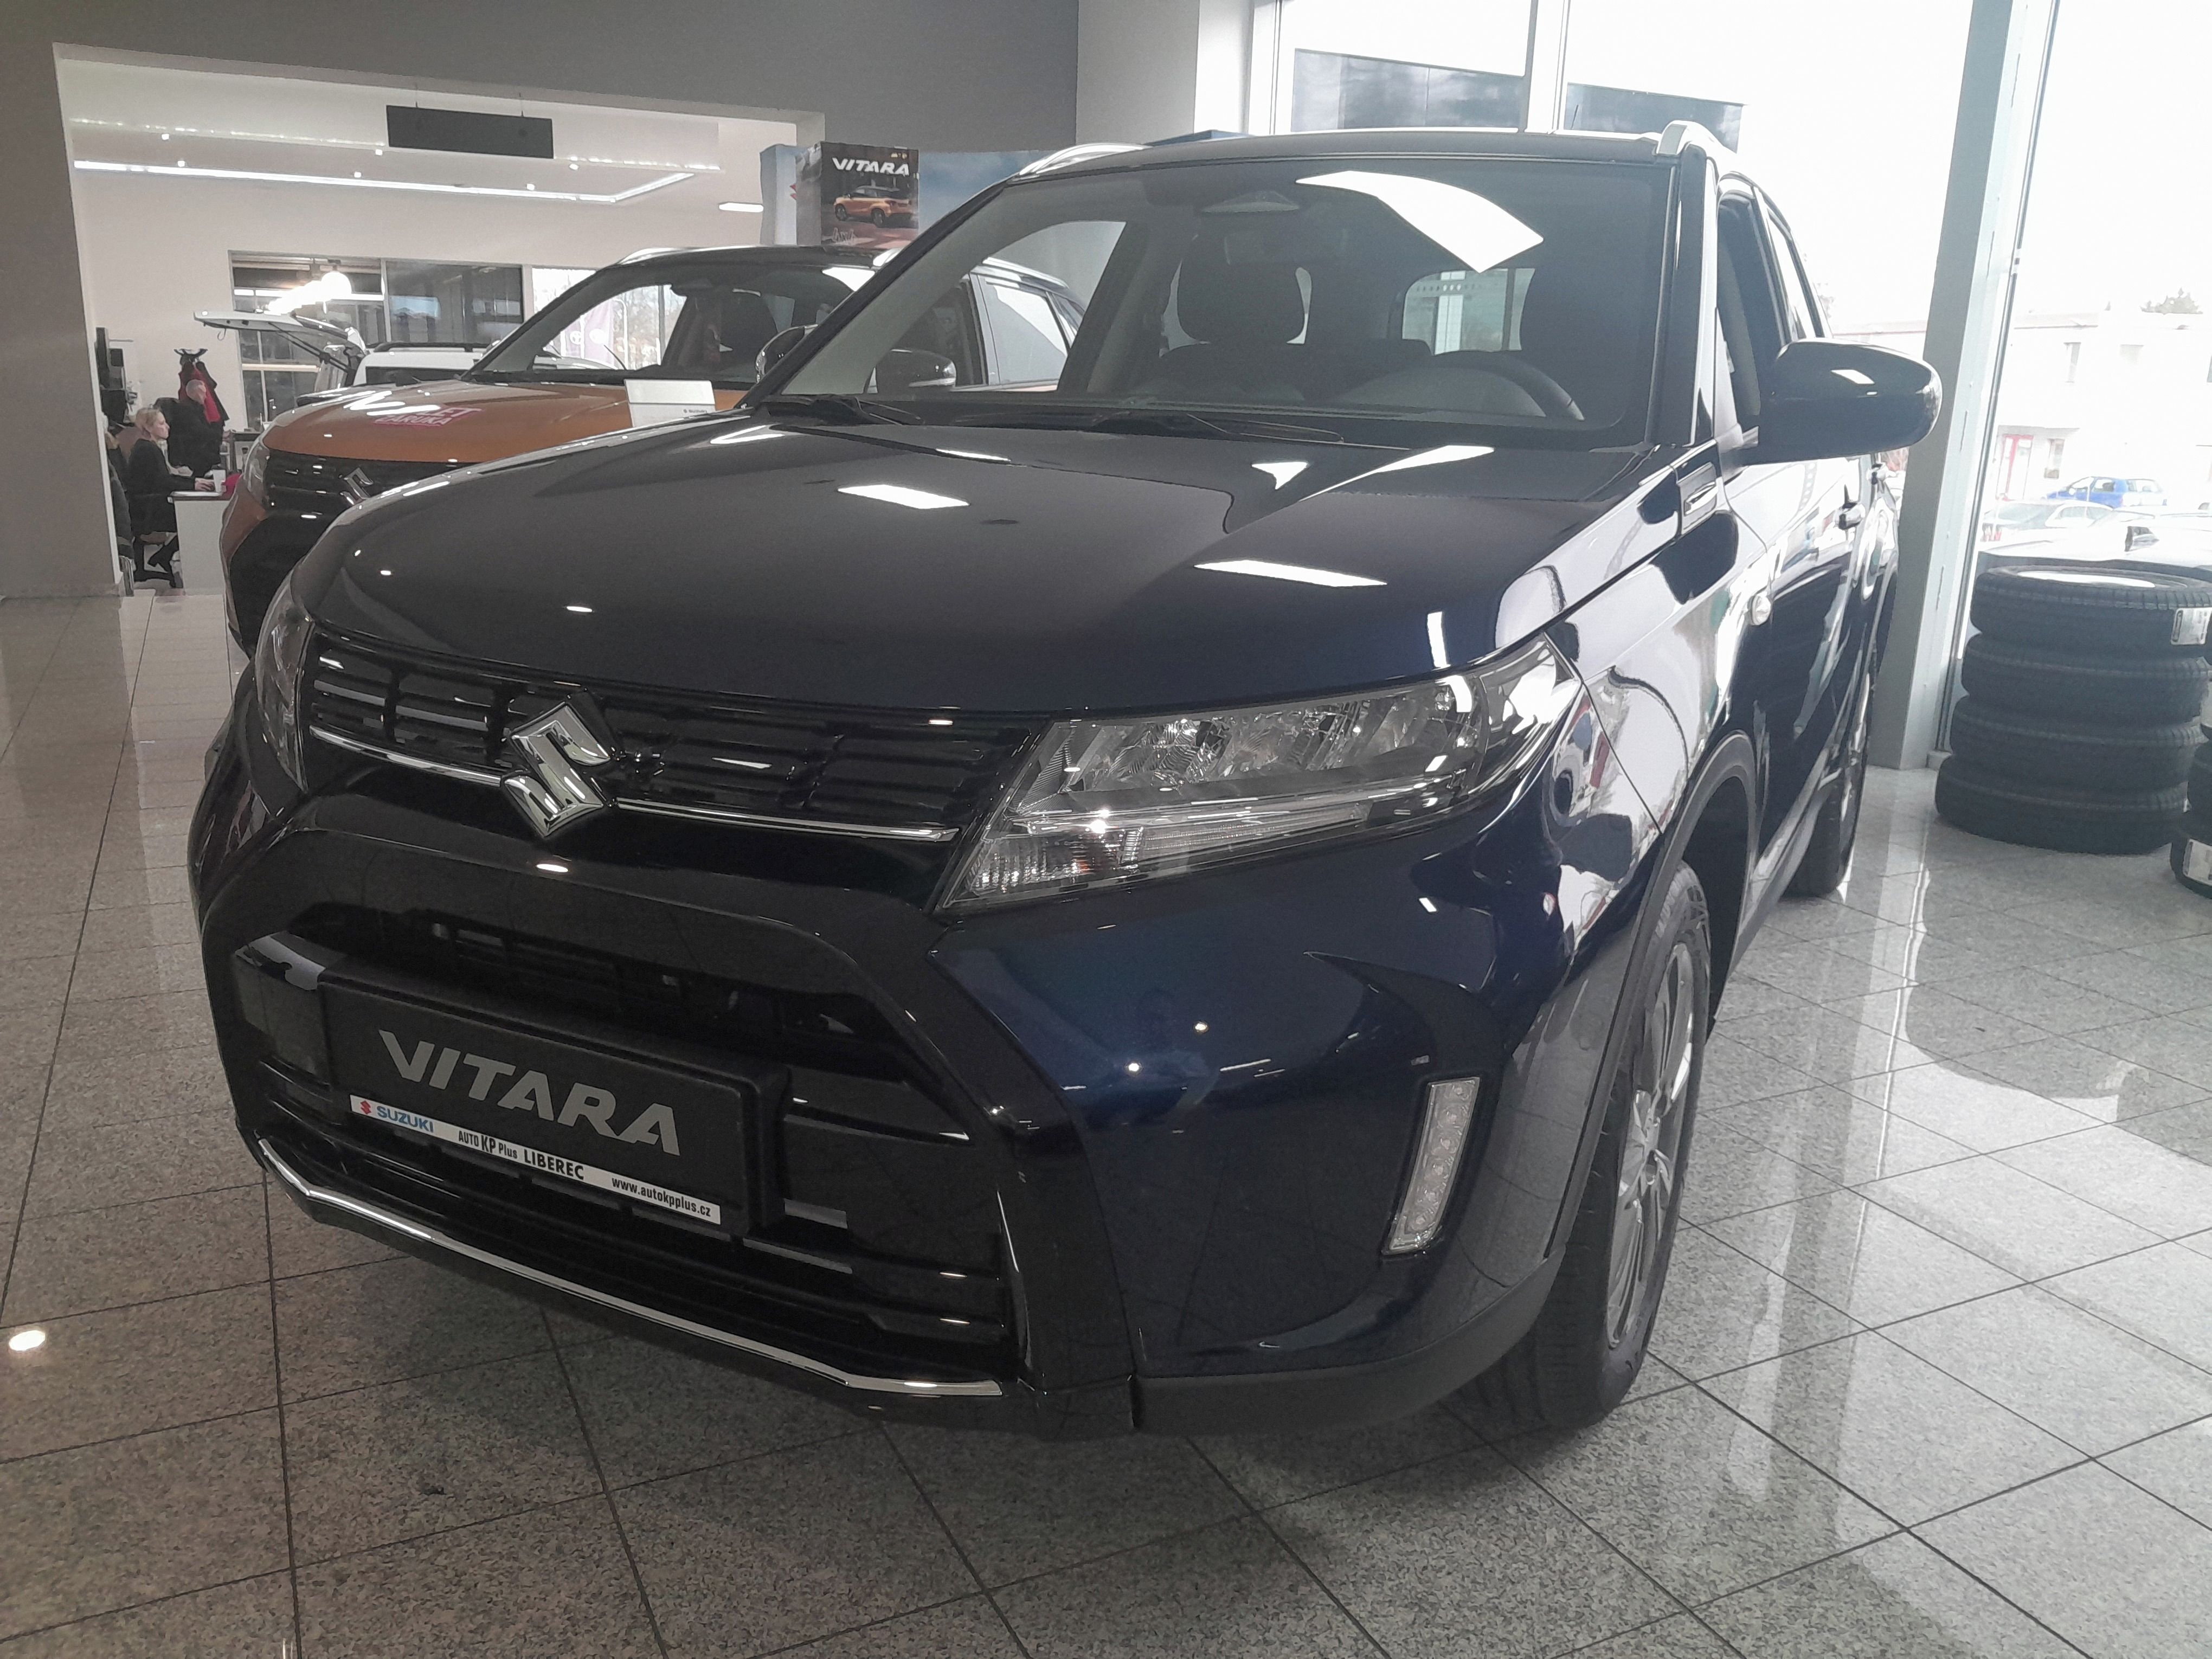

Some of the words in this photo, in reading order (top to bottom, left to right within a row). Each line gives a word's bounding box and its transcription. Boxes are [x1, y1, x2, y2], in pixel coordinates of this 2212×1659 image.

[832, 157, 910, 176] VITARA
[380, 1030, 680, 1156] VITARA
[376, 1105, 434, 1133] SUZUKI
[459, 1130, 479, 1147] AUTO
[481, 1135, 496, 1153] KP
[498, 1142, 518, 1159] Plus
[524, 1149, 584, 1180] LIBEREC
[612, 1177, 711, 1217] www.autokpplus.cz
